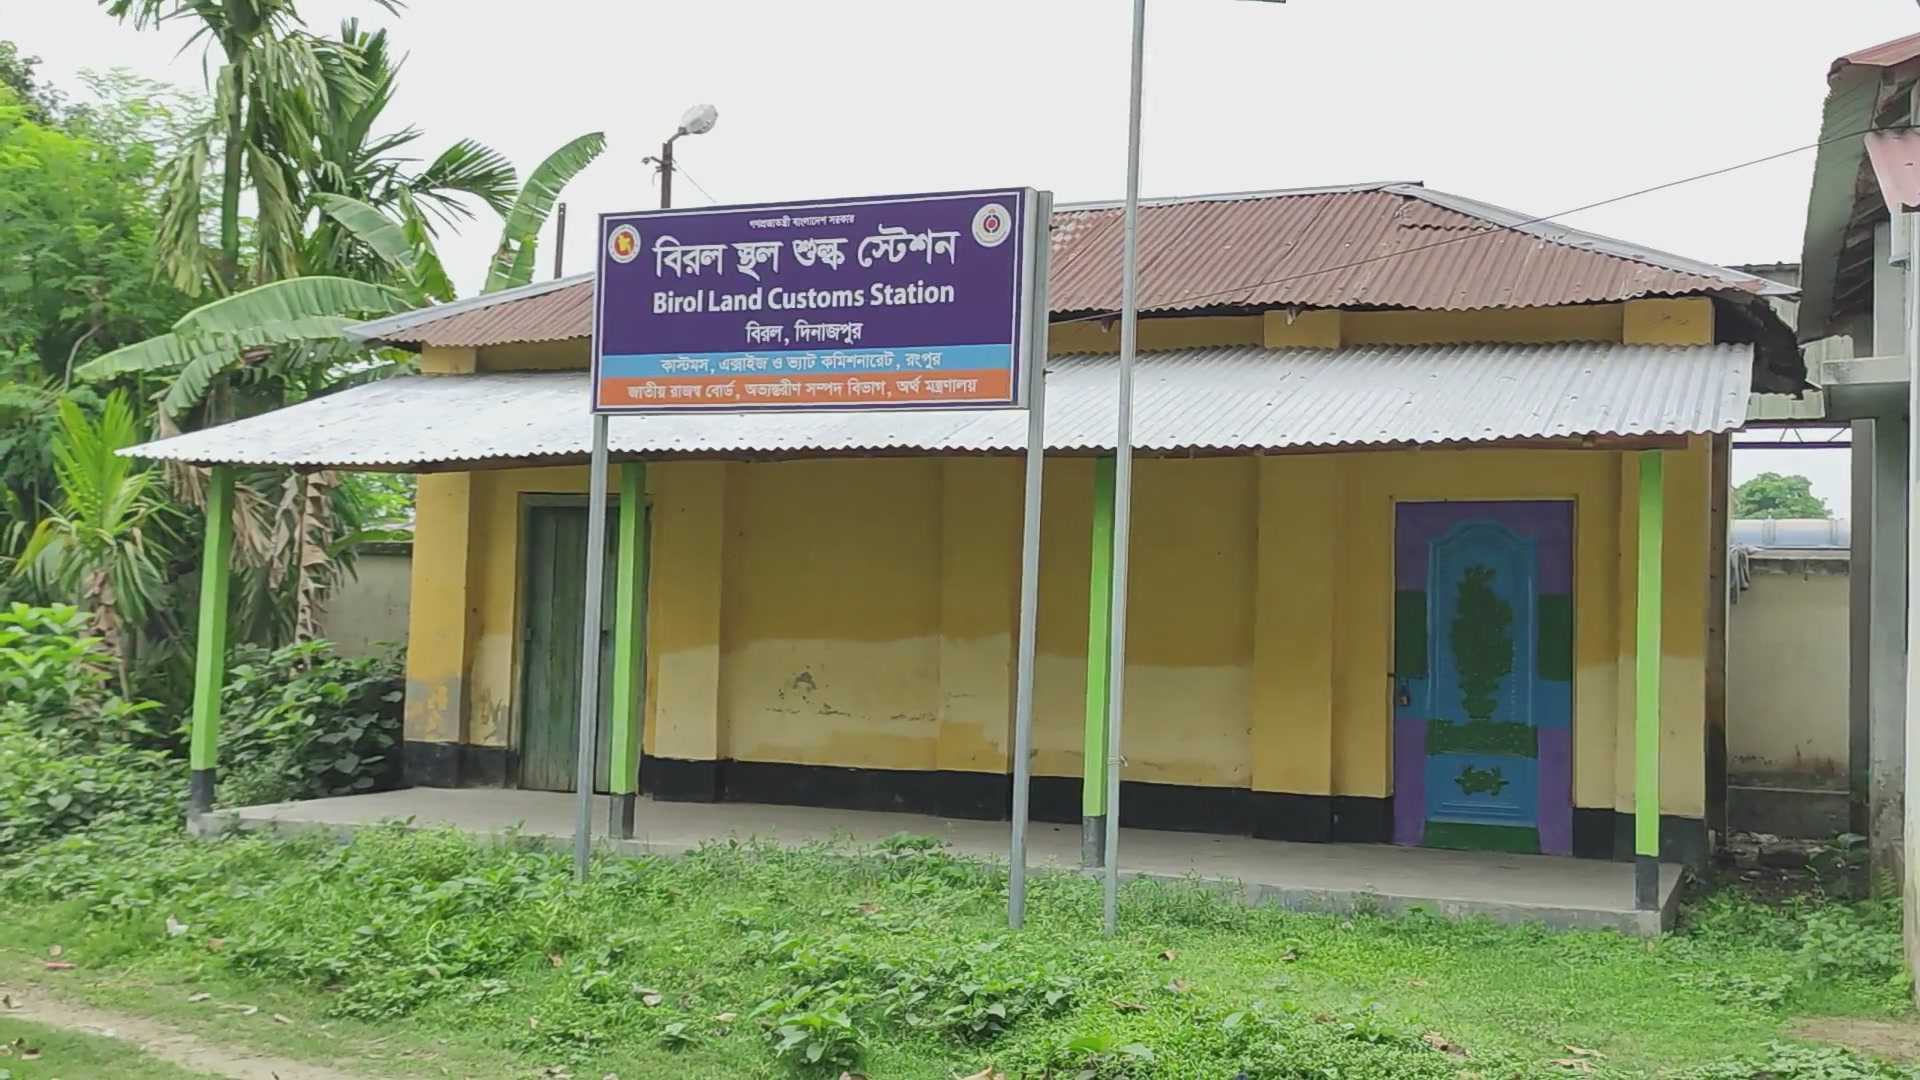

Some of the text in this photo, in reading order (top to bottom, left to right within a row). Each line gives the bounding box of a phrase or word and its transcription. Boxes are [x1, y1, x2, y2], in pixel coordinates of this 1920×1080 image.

[651, 223, 961, 281] বিরল স্থল শুল্ক স্টেশন
[653, 279, 955, 314] Birol Land Customs Station
[745, 318, 864, 346] বিরল, দিনাজপুর
[661, 350, 943, 374] কাস্টমস, এক্সাইজ ও ভ্যাট কমিশনারেট, রংপুর
[626, 380, 667, 400] জাতীয়
[704, 379, 741, 400] বোর্ড,
[805, 379, 843, 396] সম্পদ
[847, 377, 893, 398] বিভাগ,
[896, 375, 921, 394] অর্থ
[924, 378, 978, 394] মন্ত্রণালয়
